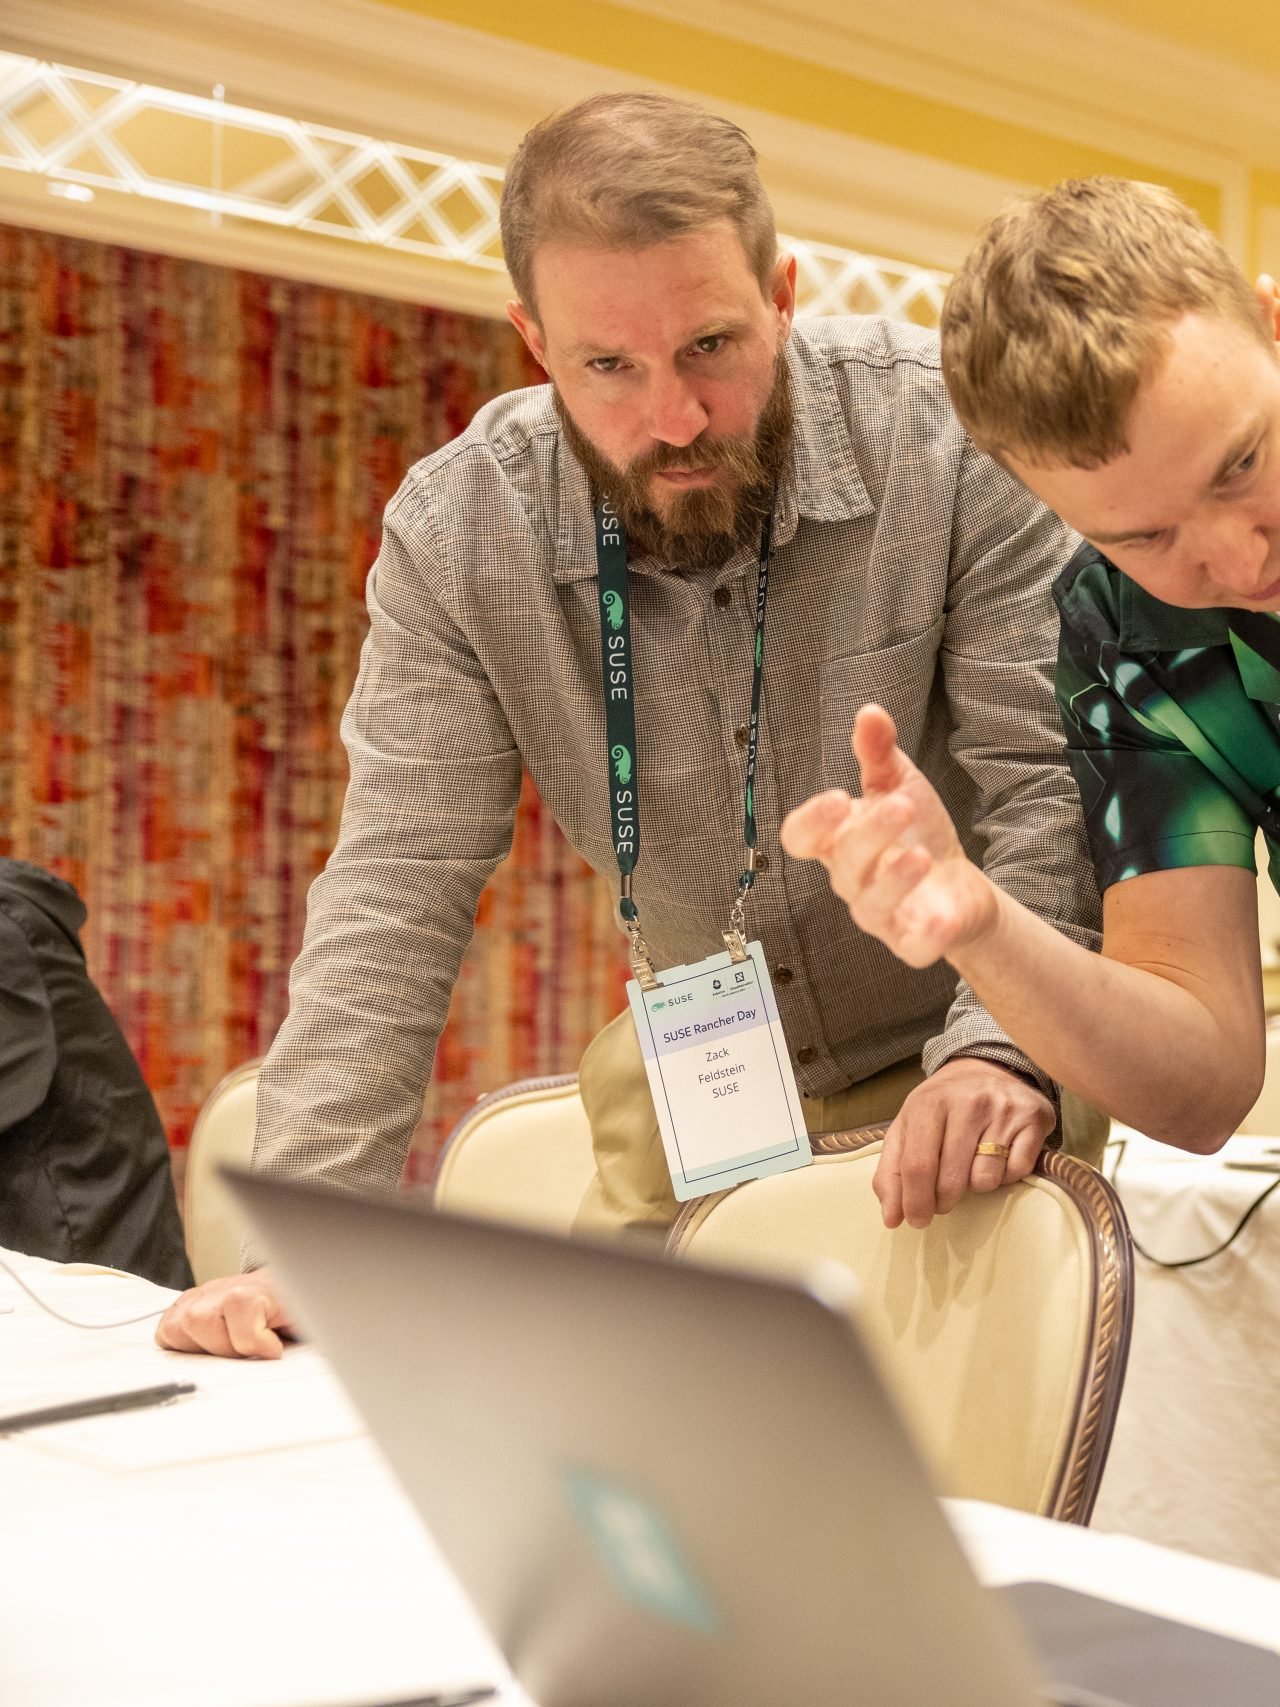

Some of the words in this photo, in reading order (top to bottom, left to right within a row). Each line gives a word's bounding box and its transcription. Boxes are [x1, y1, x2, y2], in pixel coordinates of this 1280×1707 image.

[757, 559, 769, 623] SUSE
[608, 636, 628, 701] SUSE
[748, 711, 758, 776] SUSE
[616, 790, 634, 855] SUSE
[668, 992, 694, 1007] SUSE
[663, 1026, 693, 1044] SUSE
[693, 1014, 736, 1035] Rancher
[736, 1008, 757, 1022] Day
[705, 1047, 730, 1063] Zack
[698, 1063, 746, 1085] Feldstein
[712, 1082, 740, 1099] SUSE
